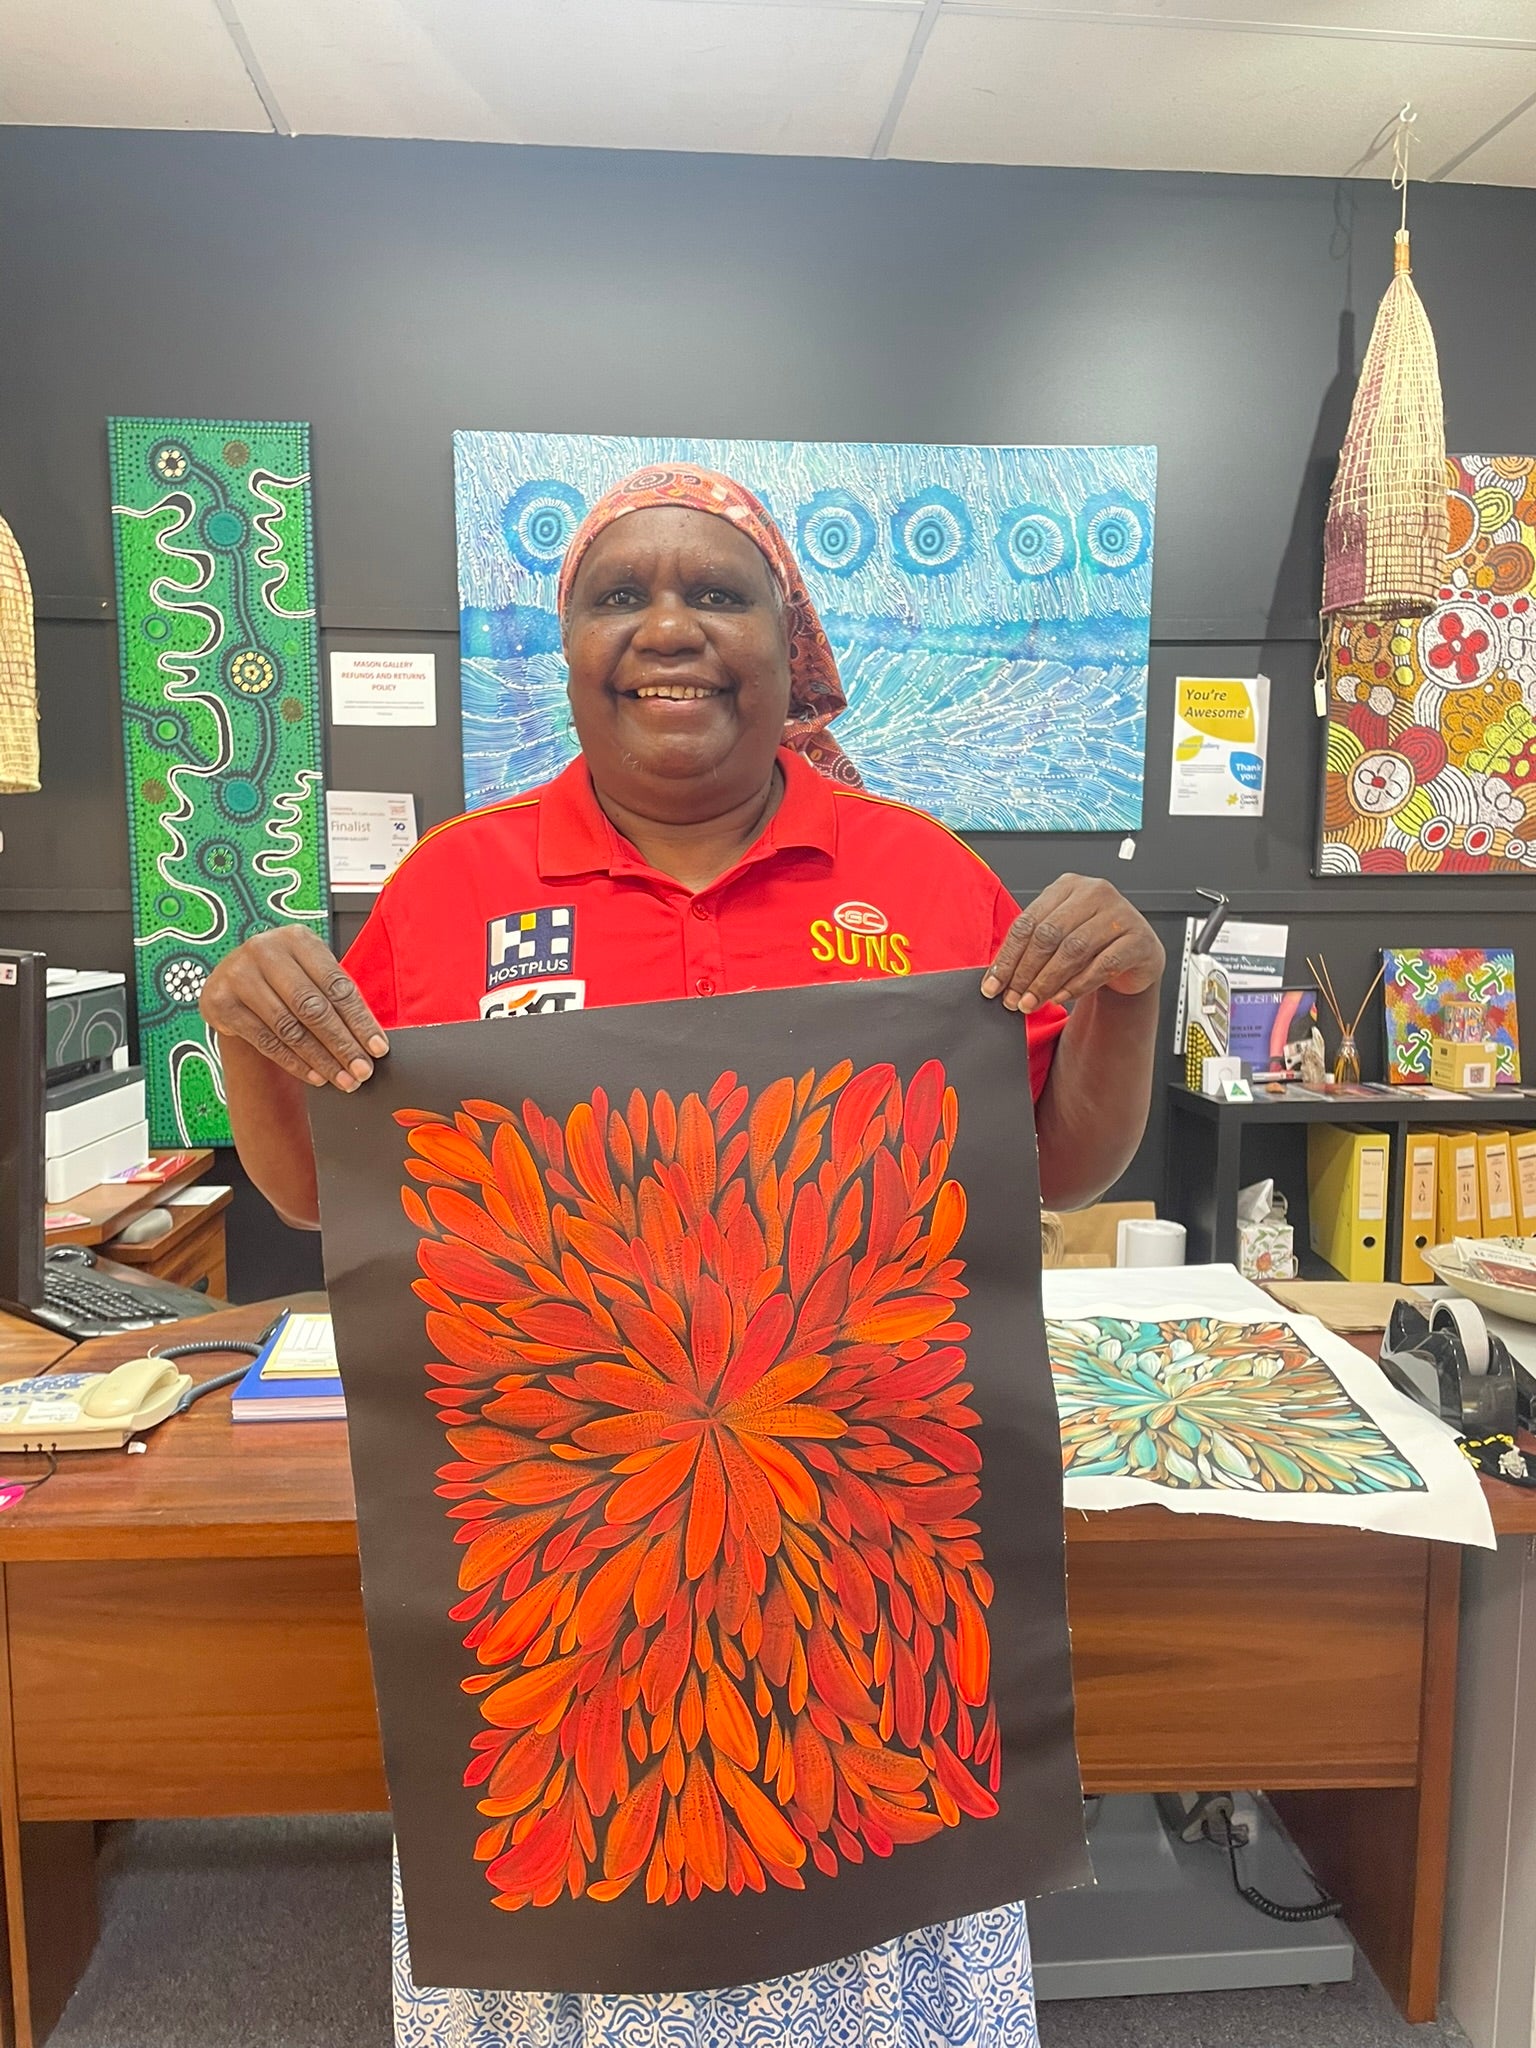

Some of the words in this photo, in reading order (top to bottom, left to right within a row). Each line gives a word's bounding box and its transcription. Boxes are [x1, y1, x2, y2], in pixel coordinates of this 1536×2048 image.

[341, 672, 374, 680] REFUNDS
[376, 672, 392, 680] AND
[1186, 689, 1227, 701] You're
[1184, 706, 1250, 719] Awesome!
[1235, 763, 1262, 771] Thank
[331, 821, 371, 832] Finalist
[810, 919, 911, 976] SUNS
[488, 959, 569, 986] HOSTPLUS
